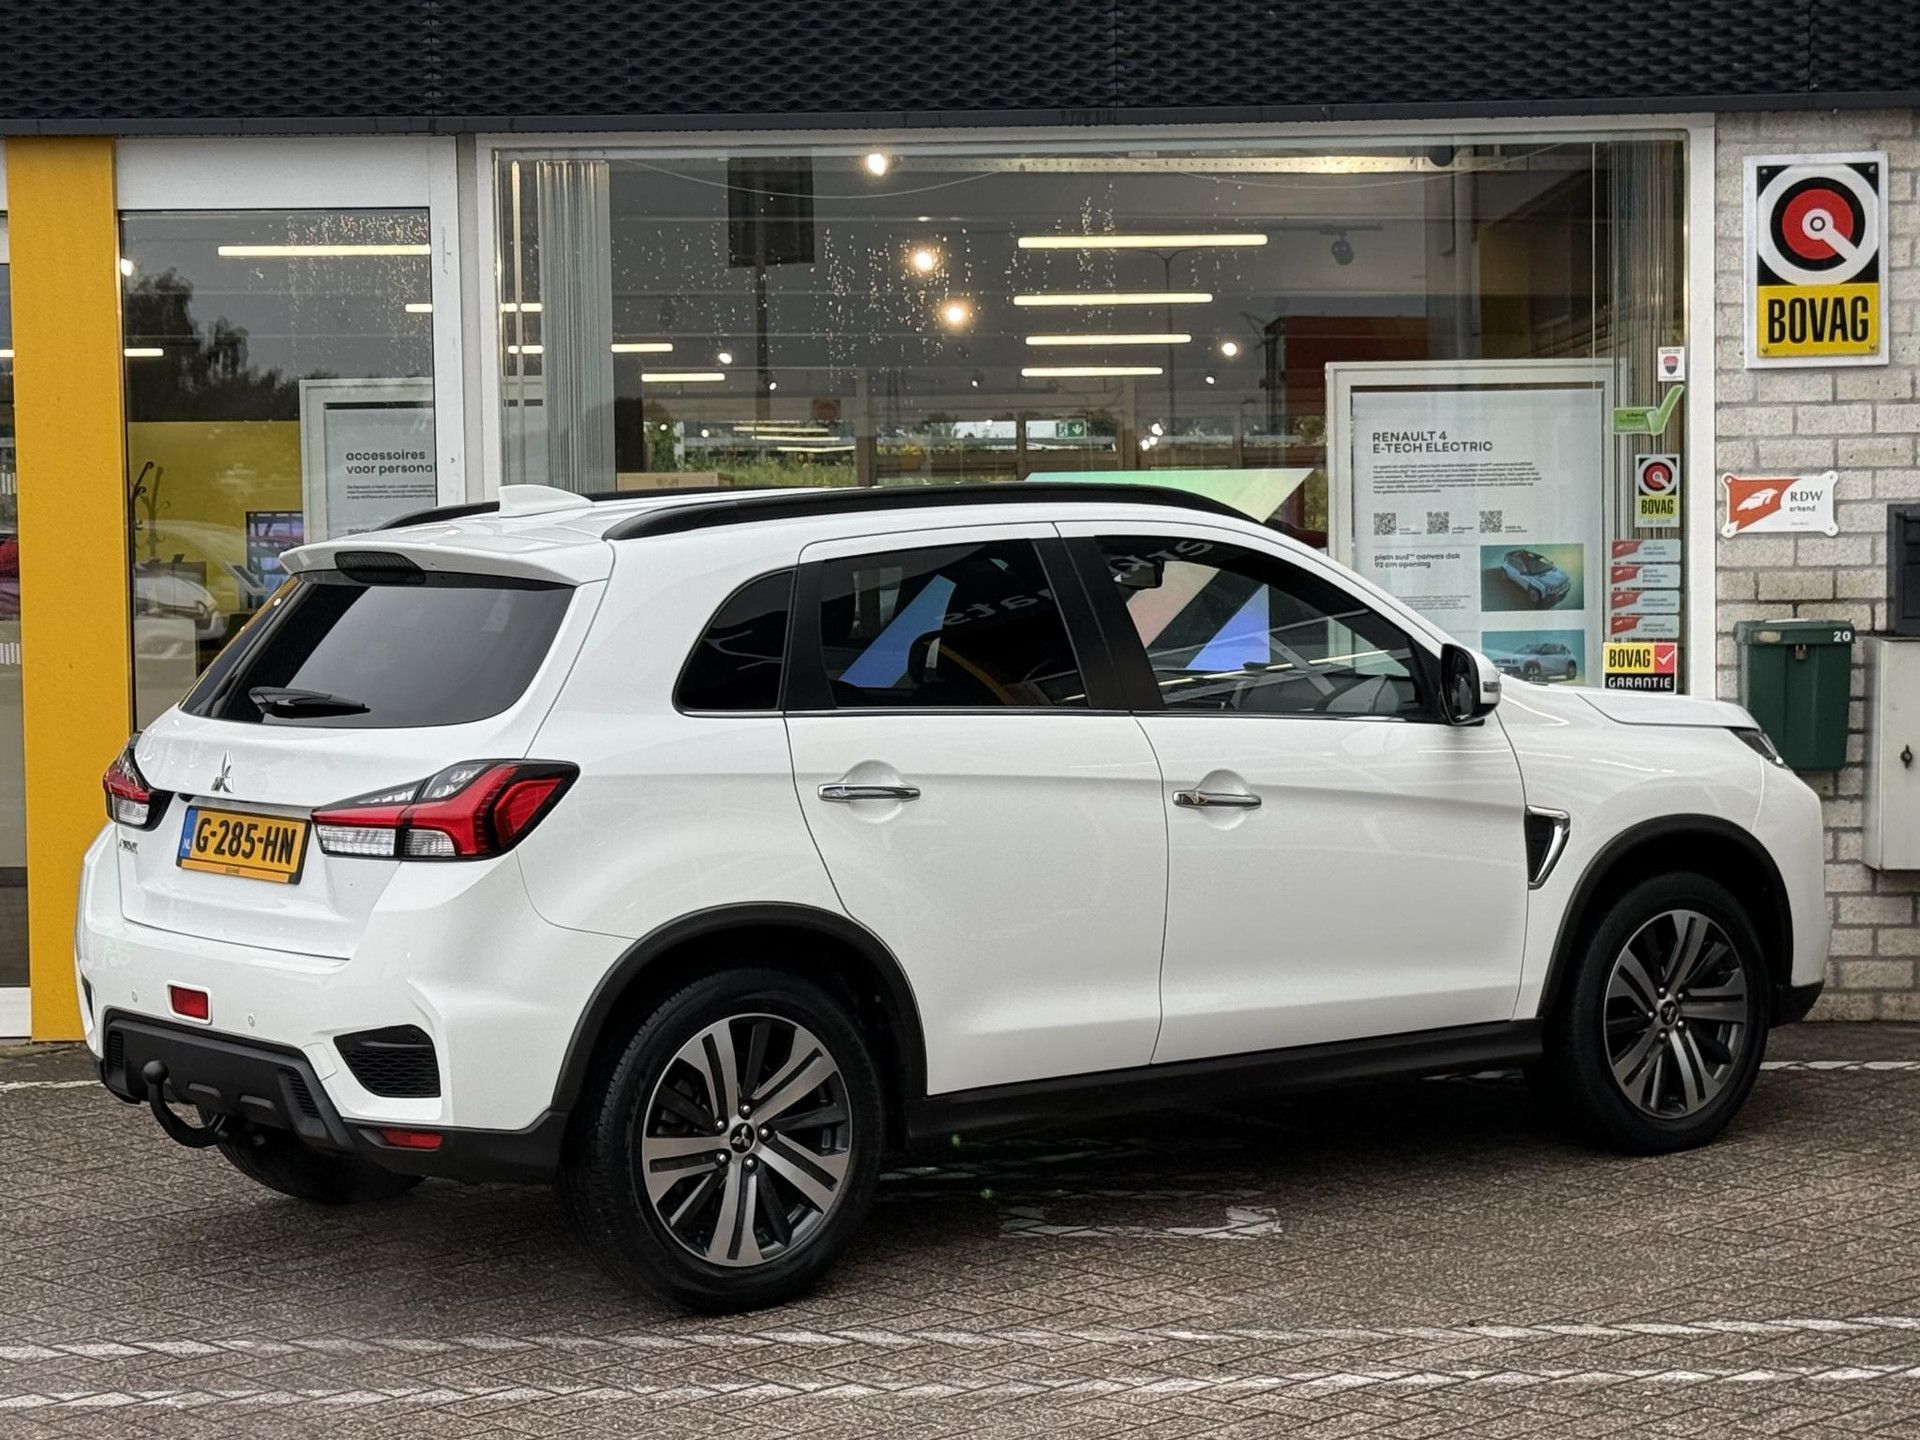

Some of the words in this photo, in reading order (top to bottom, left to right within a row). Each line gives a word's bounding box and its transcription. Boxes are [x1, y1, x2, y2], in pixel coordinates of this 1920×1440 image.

[1768, 295, 1869, 344] BOVAG
[1372, 431, 1436, 442] RENAULT
[1438, 430, 1448, 440] 4
[1372, 443, 1423, 454] E-TECH
[1425, 441, 1493, 453] ELECTRIC
[345, 449, 426, 461] accessoires
[346, 465, 376, 474] voor
[1790, 490, 1823, 502] RDW
[1641, 499, 1674, 514] BOVAG
[1833, 631, 1851, 642] 20
[1608, 649, 1651, 668] BOVAG
[1608, 676, 1672, 689] GARANTIE
[195, 817, 298, 866] G-285-HN
